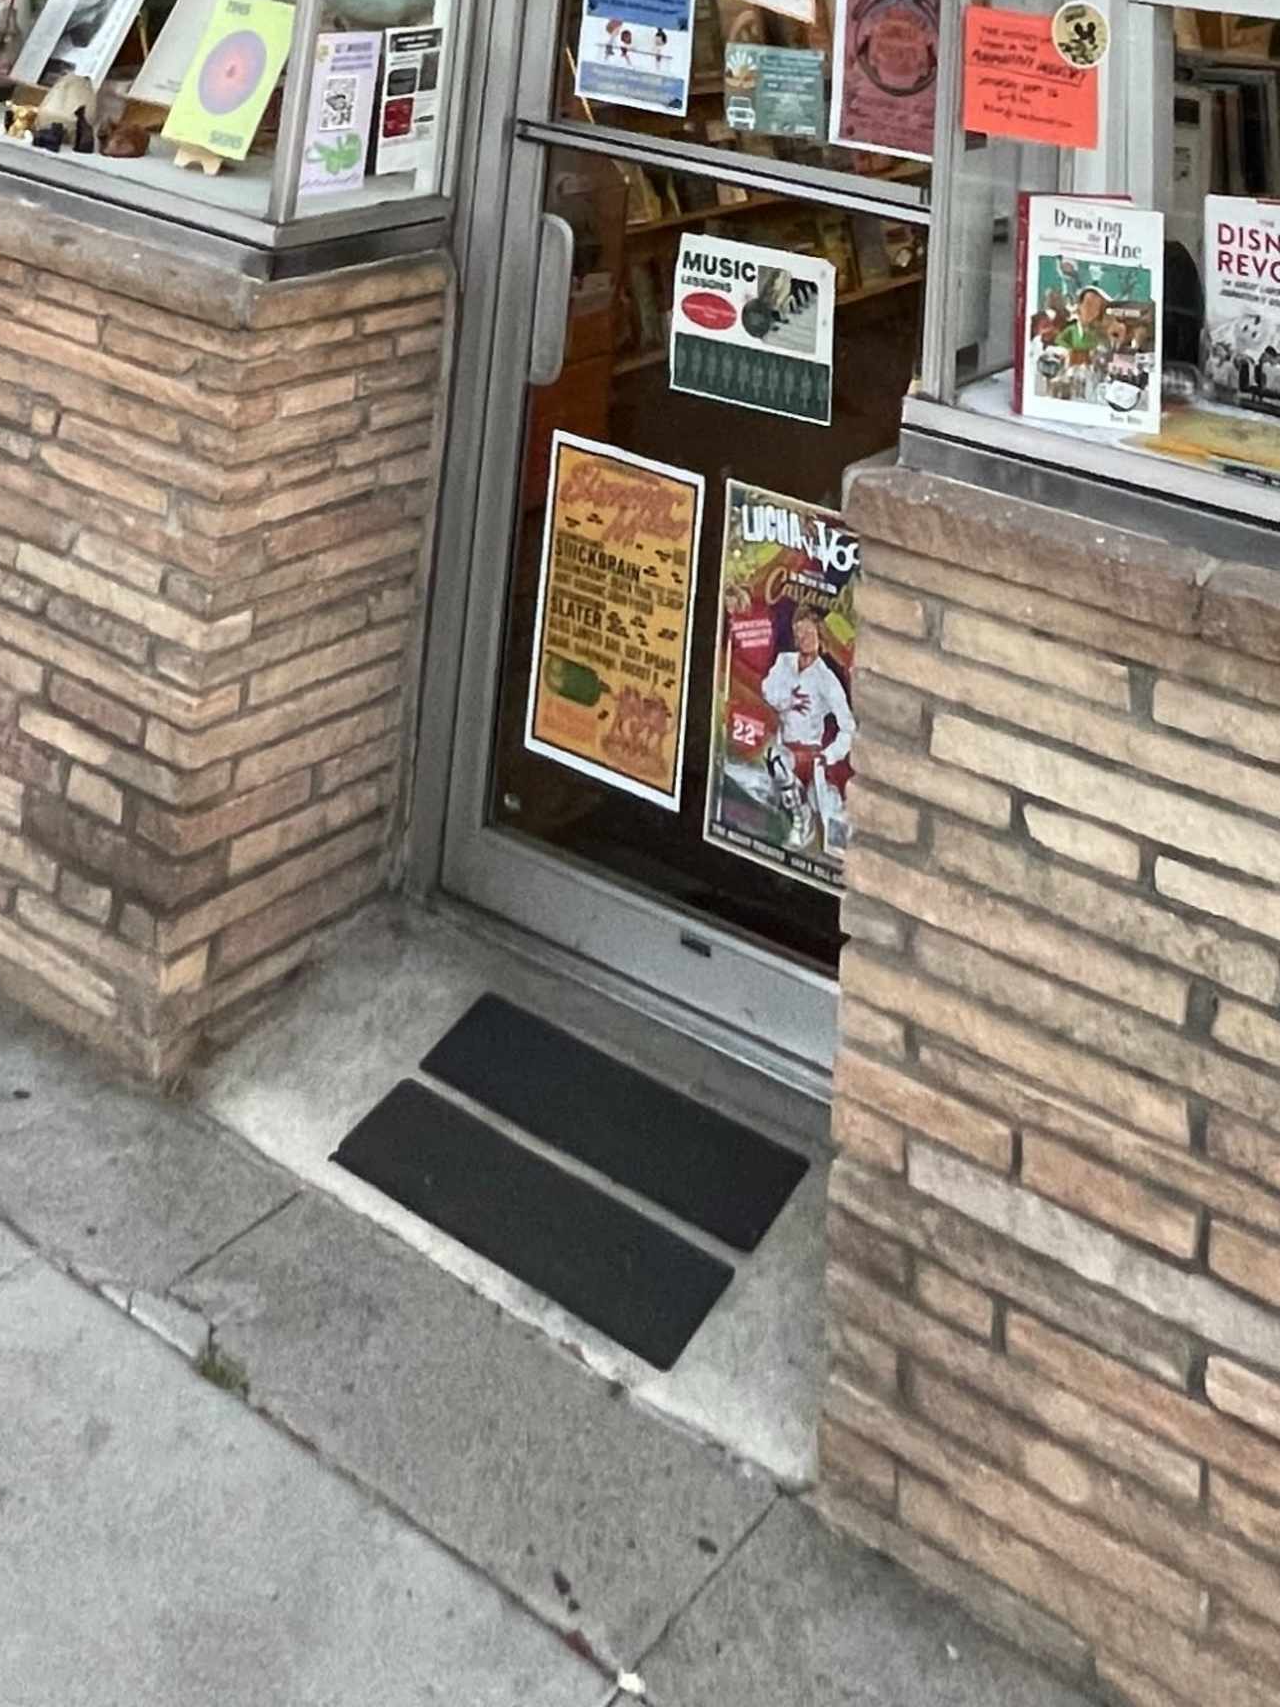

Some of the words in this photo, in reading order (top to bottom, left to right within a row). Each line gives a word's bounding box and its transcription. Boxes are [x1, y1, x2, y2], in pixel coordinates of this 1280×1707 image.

[1054, 208, 1123, 238] Drawing
[1104, 236, 1143, 260] Line
[682, 250, 757, 283] MUSIC
[681, 274, 733, 294] LESSONS
[742, 501, 801, 555] LUCHA
[549, 593, 604, 634] SLATER
